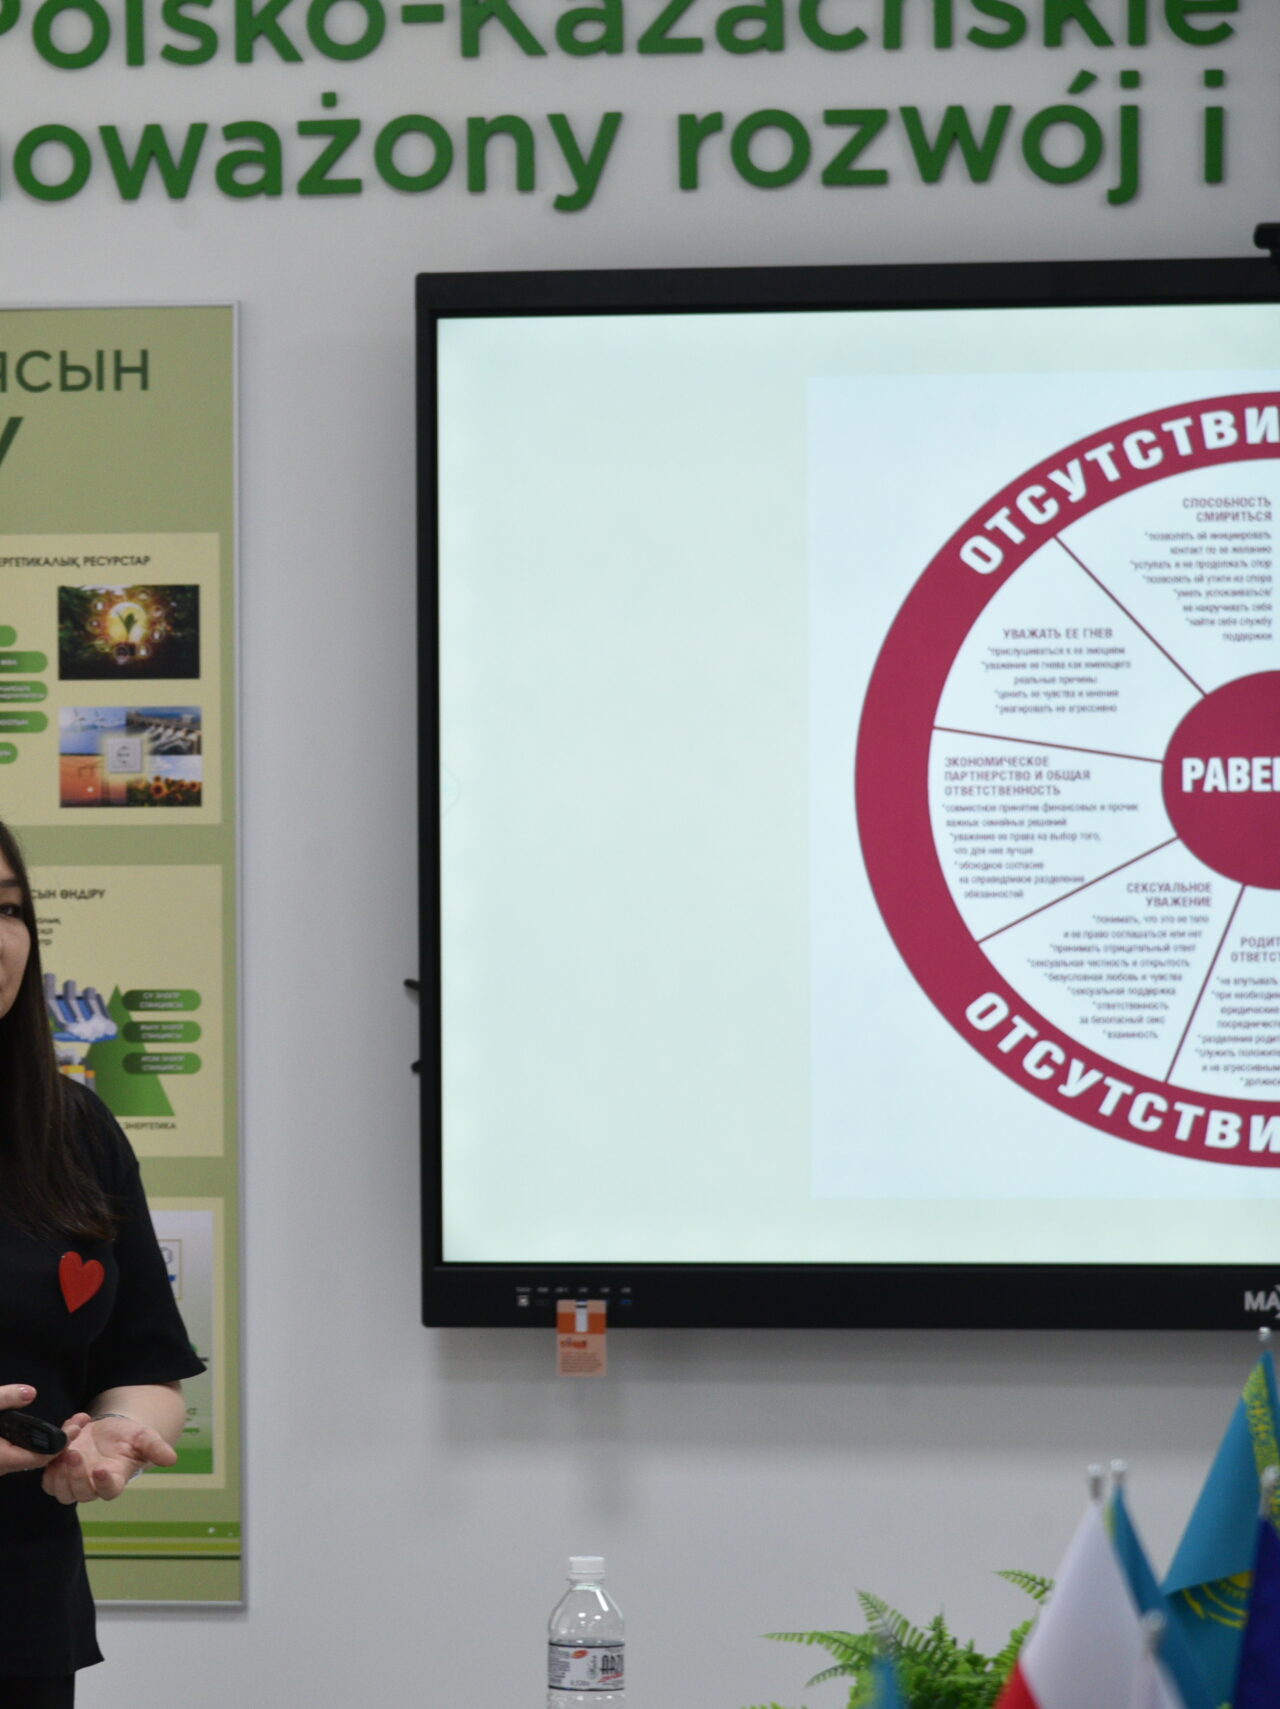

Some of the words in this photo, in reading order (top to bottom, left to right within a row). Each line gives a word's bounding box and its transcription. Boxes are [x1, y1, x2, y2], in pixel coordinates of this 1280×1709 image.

[677, 69, 1140, 206] rozwój
[1203, 69, 1224, 184] i
[959, 406, 1280, 575] ОТСУТСТВИ
[1182, 497, 1272, 509] СПОСОБНОСТЬ
[1196, 511, 1272, 522] СМИРИТЬСЯ
[83, 555, 151, 567] РЕСУРСТАР
[1002, 628, 1062, 639] УВАЖАТЬ
[1065, 628, 1078, 639] ЕЕ
[1083, 628, 1112, 639] ГНЕВ
[944, 756, 1049, 767] ЭКОНОМИЧЕСКОЕ
[944, 770, 1031, 781] ПАРТНЕРСТВО
[1035, 770, 1043, 781] И
[1047, 770, 1091, 782] ОБЩАЯ
[944, 785, 1061, 796] ОТВЕТСТВЕННОСТЬ
[1126, 883, 1213, 893] СЕКСУАЛЬНОЕ
[1146, 896, 1213, 907] УВАЖЕНИЕ
[965, 992, 1280, 1153] ОТСУТСТВИ
